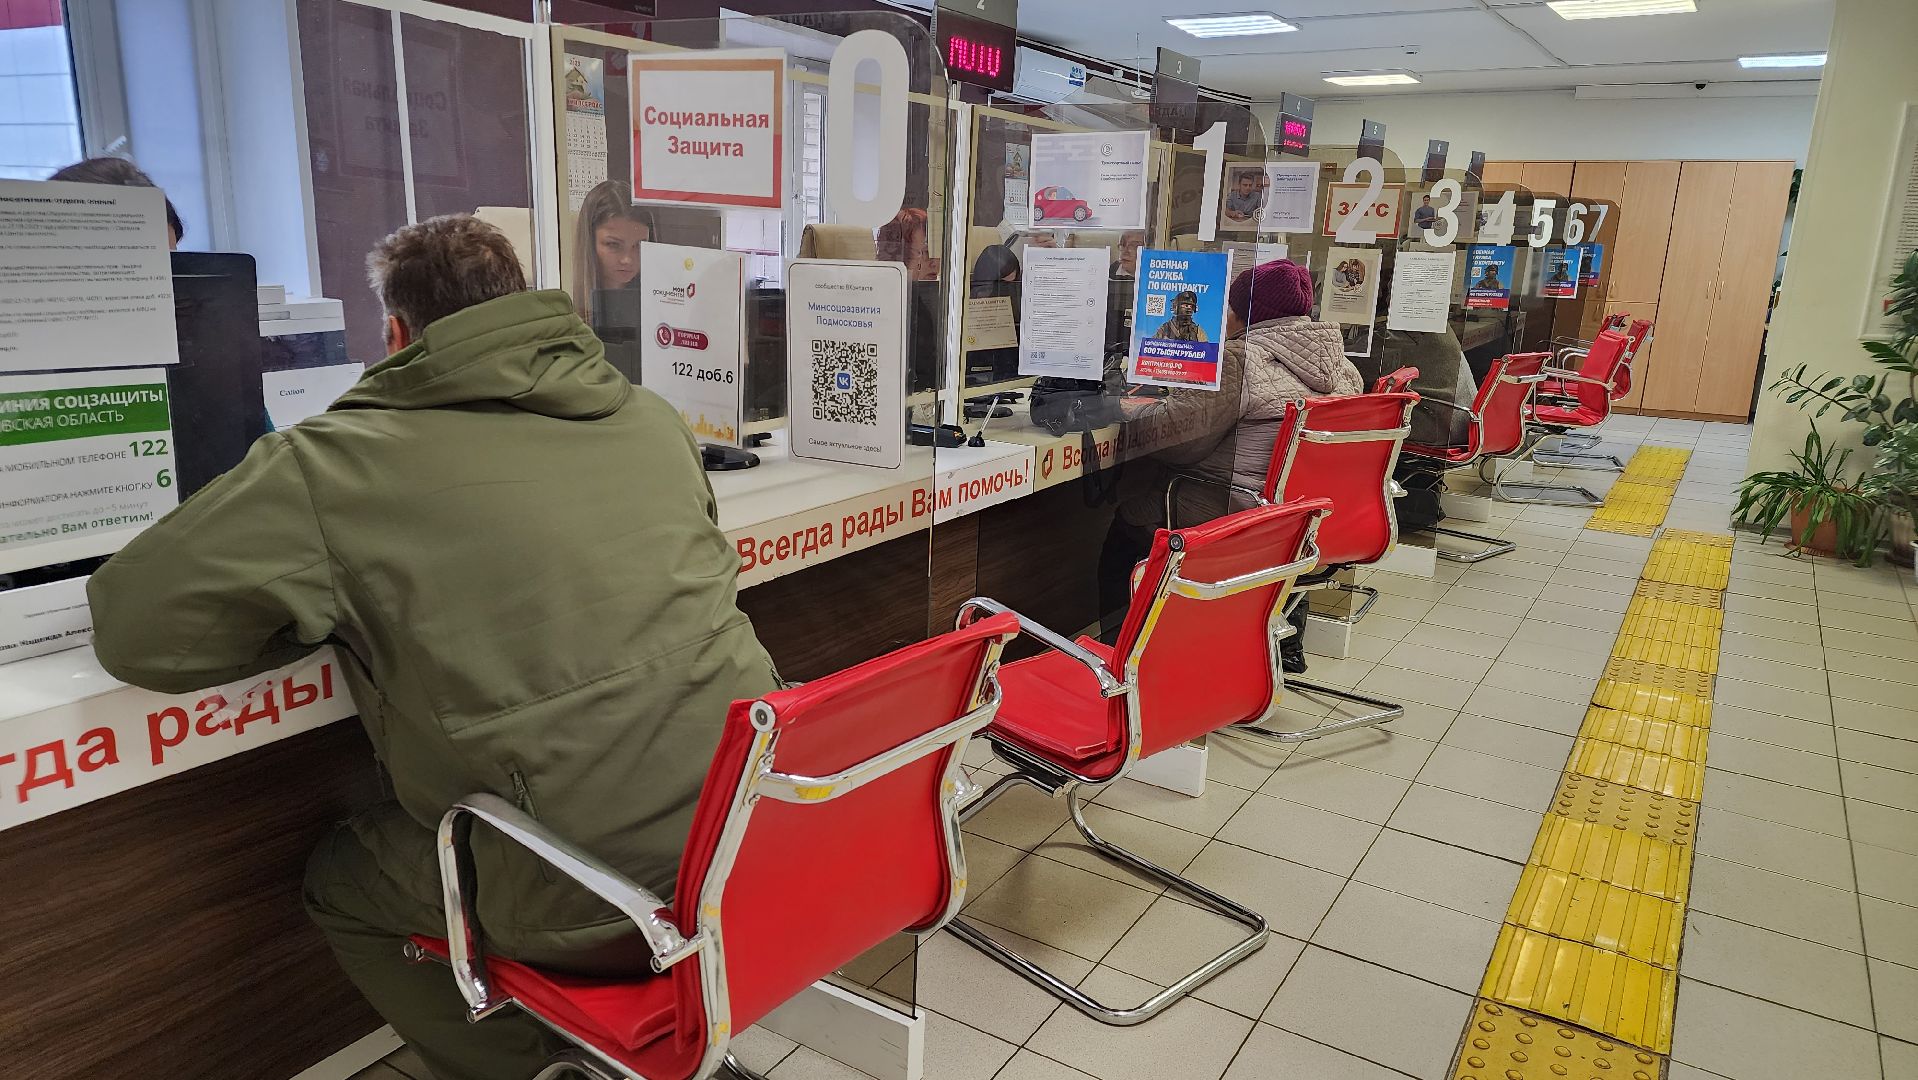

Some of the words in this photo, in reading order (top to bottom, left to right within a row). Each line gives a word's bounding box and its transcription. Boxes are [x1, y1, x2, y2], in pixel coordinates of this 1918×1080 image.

[1176, 60, 1182, 75] 3
[644, 106, 769, 129] Социальная
[827, 29, 910, 228] 0
[667, 135, 744, 159] Защита
[1192, 121, 1227, 241] 1
[1335, 156, 1384, 244] 2
[1338, 201, 1390, 217] ЗС
[1424, 178, 1461, 247] 3
[1483, 190, 1515, 246] 4
[1529, 199, 1556, 248] 5
[1564, 202, 1587, 246] 6
[1588, 204, 1608, 242] 7
[1149, 259, 1189, 270] ВОЕННАЯ
[1149, 270, 1184, 281] СЛУЖБА
[1147, 281, 1160, 290] ПО
[1160, 282, 1210, 293] КОНТРАКТУ
[808, 301, 881, 315] Минсоцразвития
[816, 315, 873, 328] Подмосковья
[672, 361, 693, 377] 122
[697, 368, 734, 384] доб.6
[54, 389, 163, 410] СОЦЗАЩИТЫ
[56, 410, 125, 427] ОБЛАСТЬ
[78, 451, 127, 464] ТЕЛЕФОНЕ
[128, 439, 169, 457] 122
[70, 486, 114, 498] НАЖМИТЕ
[156, 468, 171, 488] 6
[61, 521, 88, 534] Вам
[91, 511, 154, 529] ответим!
[736, 521, 833, 573] Всегда
[842, 500, 904, 548] рады
[911, 487, 952, 518] Вам
[958, 458, 1029, 504] помочь!
[147, 664, 333, 766] рады
